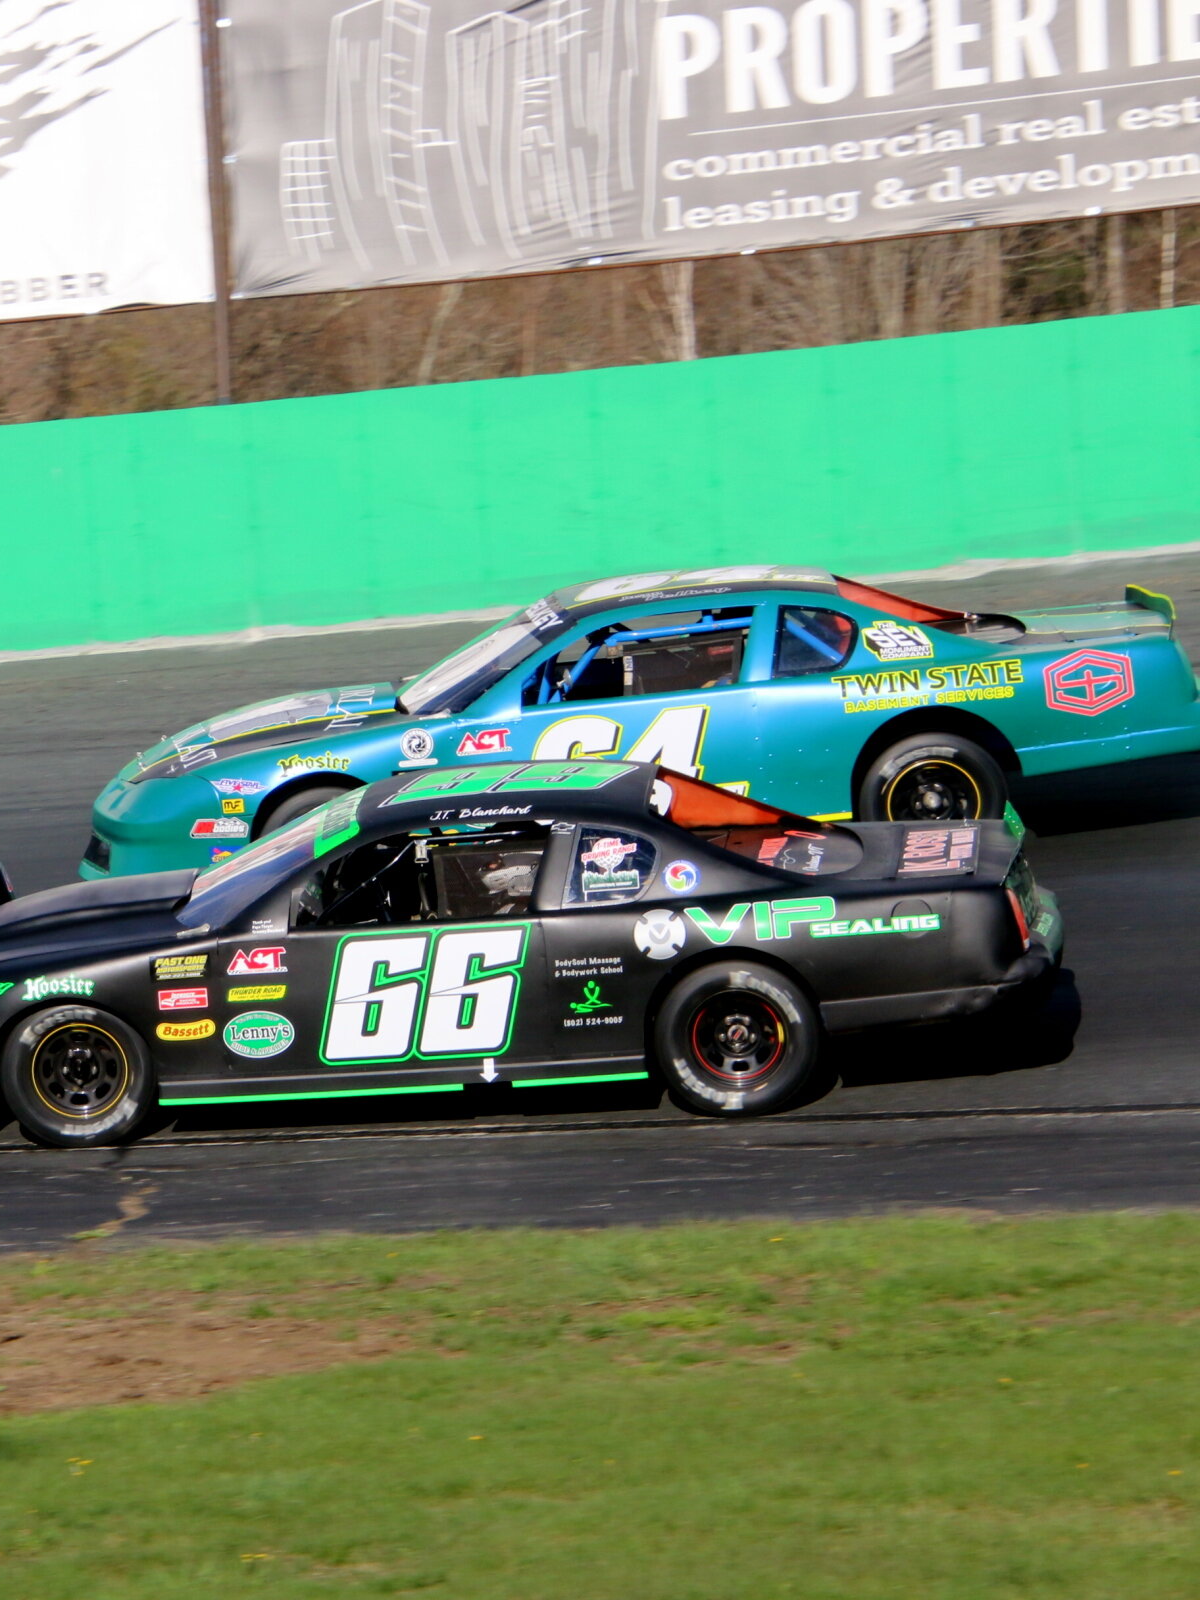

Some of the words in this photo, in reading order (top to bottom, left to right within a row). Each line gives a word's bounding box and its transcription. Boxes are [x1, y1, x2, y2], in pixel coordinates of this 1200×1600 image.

[662, 113, 985, 182] commercial
[996, 100, 1107, 146] real
[662, 188, 861, 232] leasing
[871, 177, 920, 209] &
[832, 669, 921, 699] TWIN
[929, 659, 1024, 690] STATE
[844, 693, 929, 713] BASEMENT
[935, 686, 1015, 704] SERVICES
[277, 752, 351, 778] Hoosier
[459, 805, 533, 819] Blanchard
[684, 896, 836, 945] VIP
[810, 913, 941, 938] SEALING
[155, 957, 185, 968] FAST
[184, 955, 208, 965] ONE
[562, 968, 597, 977] Bodywork
[600, 966, 623, 974] School
[589, 957, 621, 966] Massage
[22, 975, 95, 1001] Hoosier
[231, 988, 262, 996] THUNDER
[263, 986, 282, 994] ROAD
[319, 922, 532, 1065] 66
[163, 1023, 210, 1037] Bassett
[230, 1024, 290, 1042] Lenny's
